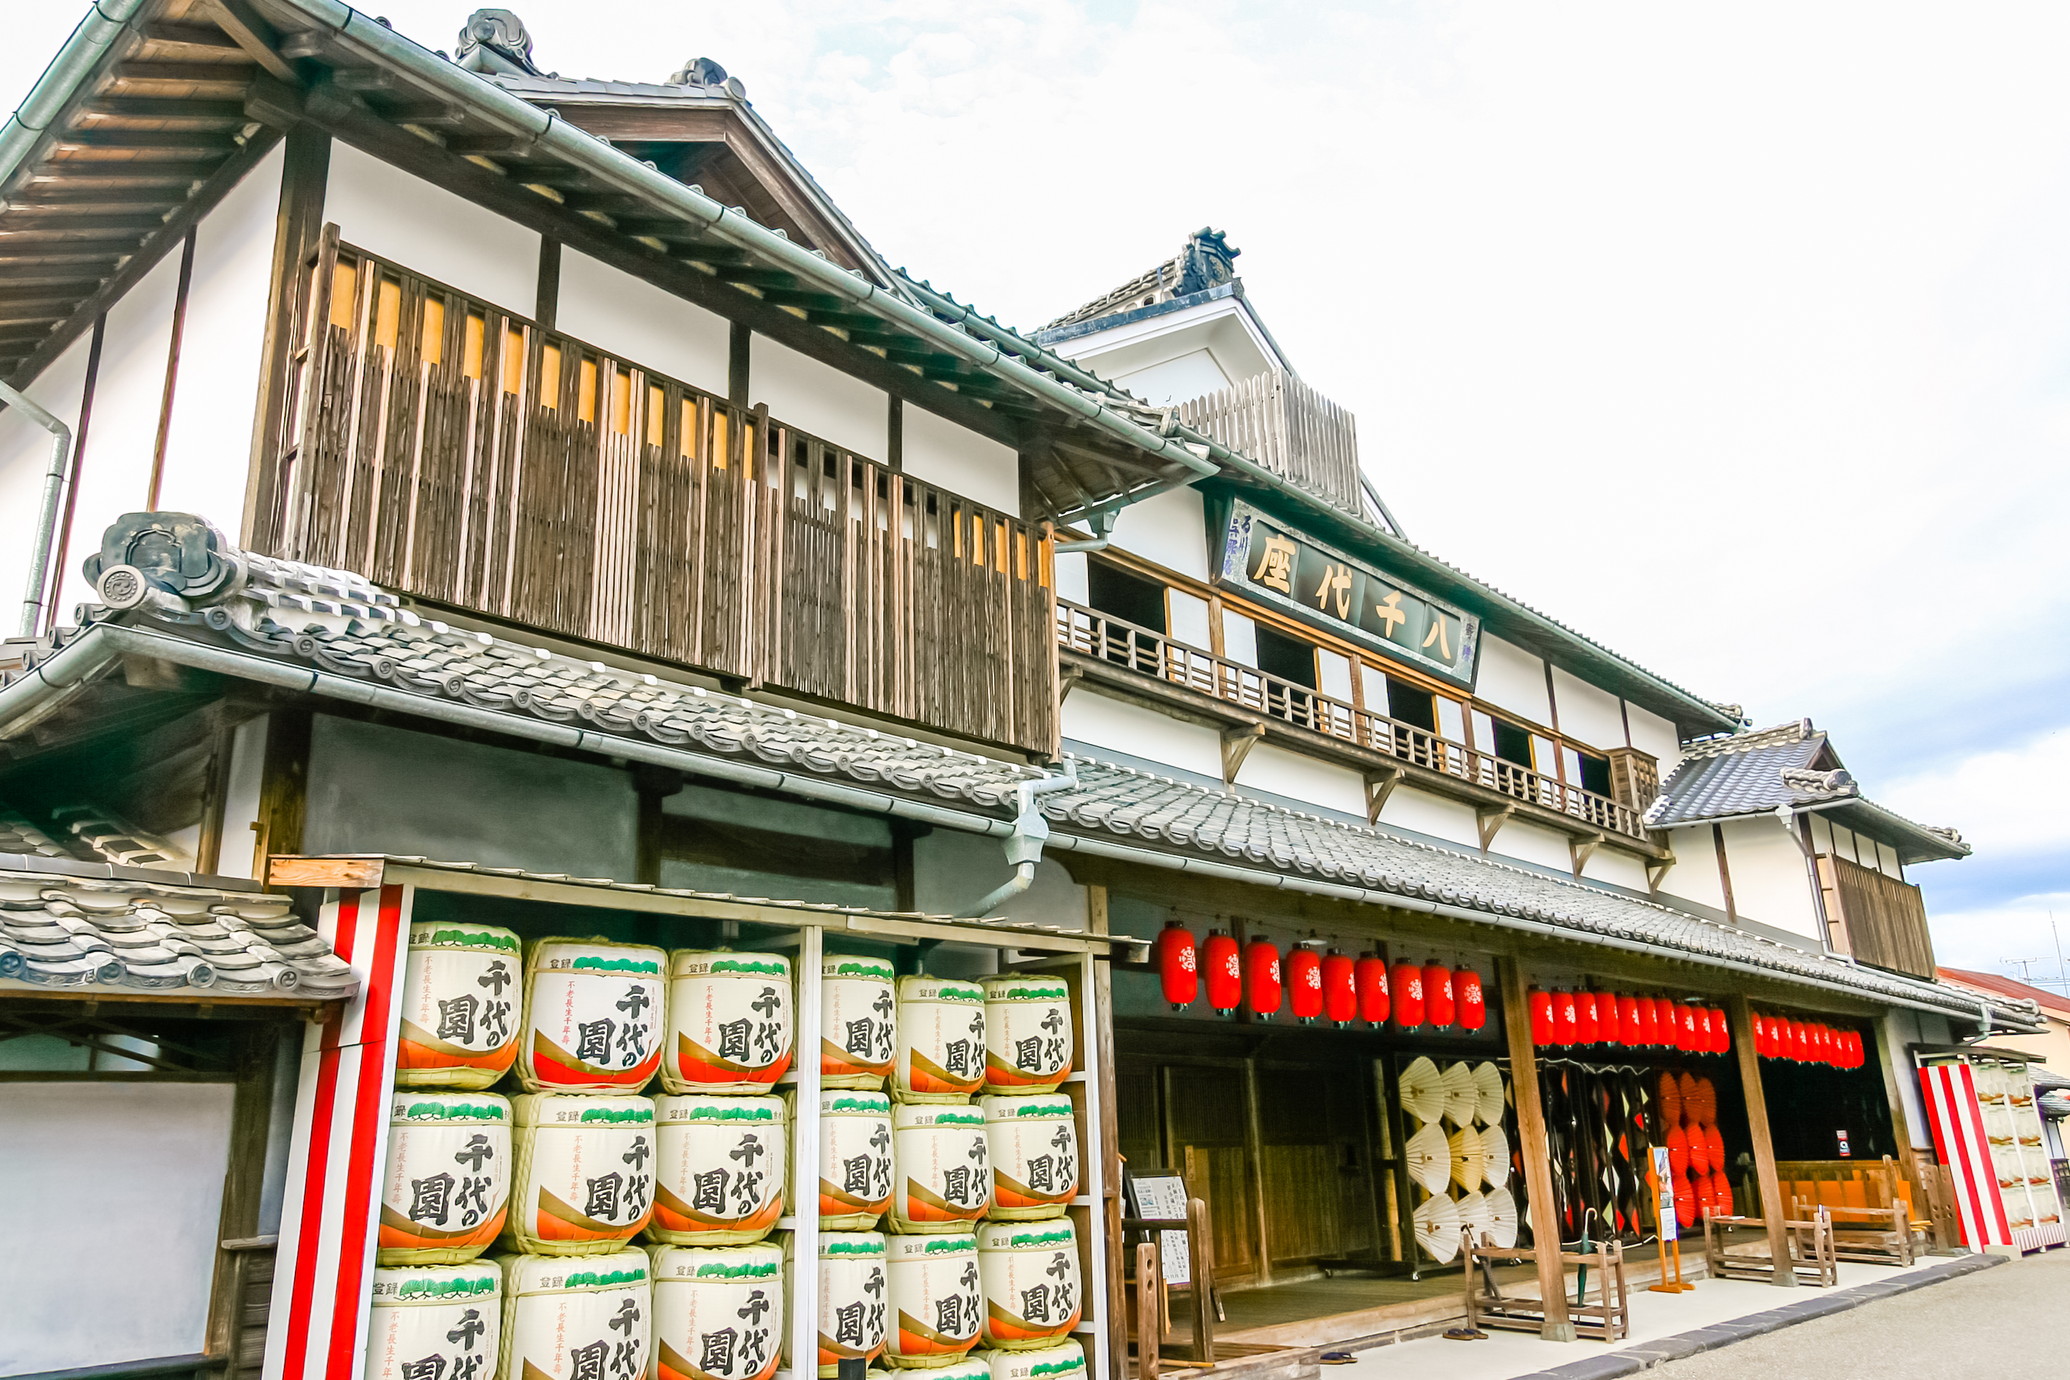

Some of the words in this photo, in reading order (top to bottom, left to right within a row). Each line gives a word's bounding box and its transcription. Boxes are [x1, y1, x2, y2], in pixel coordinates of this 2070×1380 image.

[1253, 534, 1451, 660] 八千代座
[436, 994, 479, 1045] 園
[477, 960, 511, 1046] 千代の
[616, 985, 650, 1067] 千代の
[751, 987, 781, 1063] 千代の
[873, 990, 893, 1060] 千代の
[576, 1018, 616, 1065] 園
[718, 1018, 753, 1062] 園
[846, 1017, 874, 1058] 園
[946, 1038, 970, 1077] 園
[969, 1012, 985, 1078] 千代の
[1015, 1035, 1043, 1071] 園
[1041, 1008, 1065, 1071] 千代の
[455, 1134, 493, 1226] 千代の
[622, 1135, 650, 1221] 千代の
[729, 1134, 764, 1214] 千代の
[844, 1153, 872, 1196] 園
[869, 1123, 891, 1197] 千代の
[944, 1165, 970, 1205] 園
[968, 1136, 987, 1205] 千代の
[1027, 1153, 1054, 1191] 園
[1051, 1125, 1073, 1191] 千代の
[408, 1172, 455, 1226] 園
[584, 1172, 623, 1221] 園
[692, 1167, 730, 1214] 園
[864, 1266, 885, 1346] 千代の
[936, 1293, 962, 1335] 園
[960, 1261, 979, 1334] 千代の
[1021, 1283, 1049, 1322] 園
[1046, 1252, 1073, 1320] 千代の
[699, 1327, 738, 1376] 園
[737, 1290, 769, 1375] 千代の
[835, 1300, 866, 1346] 園
